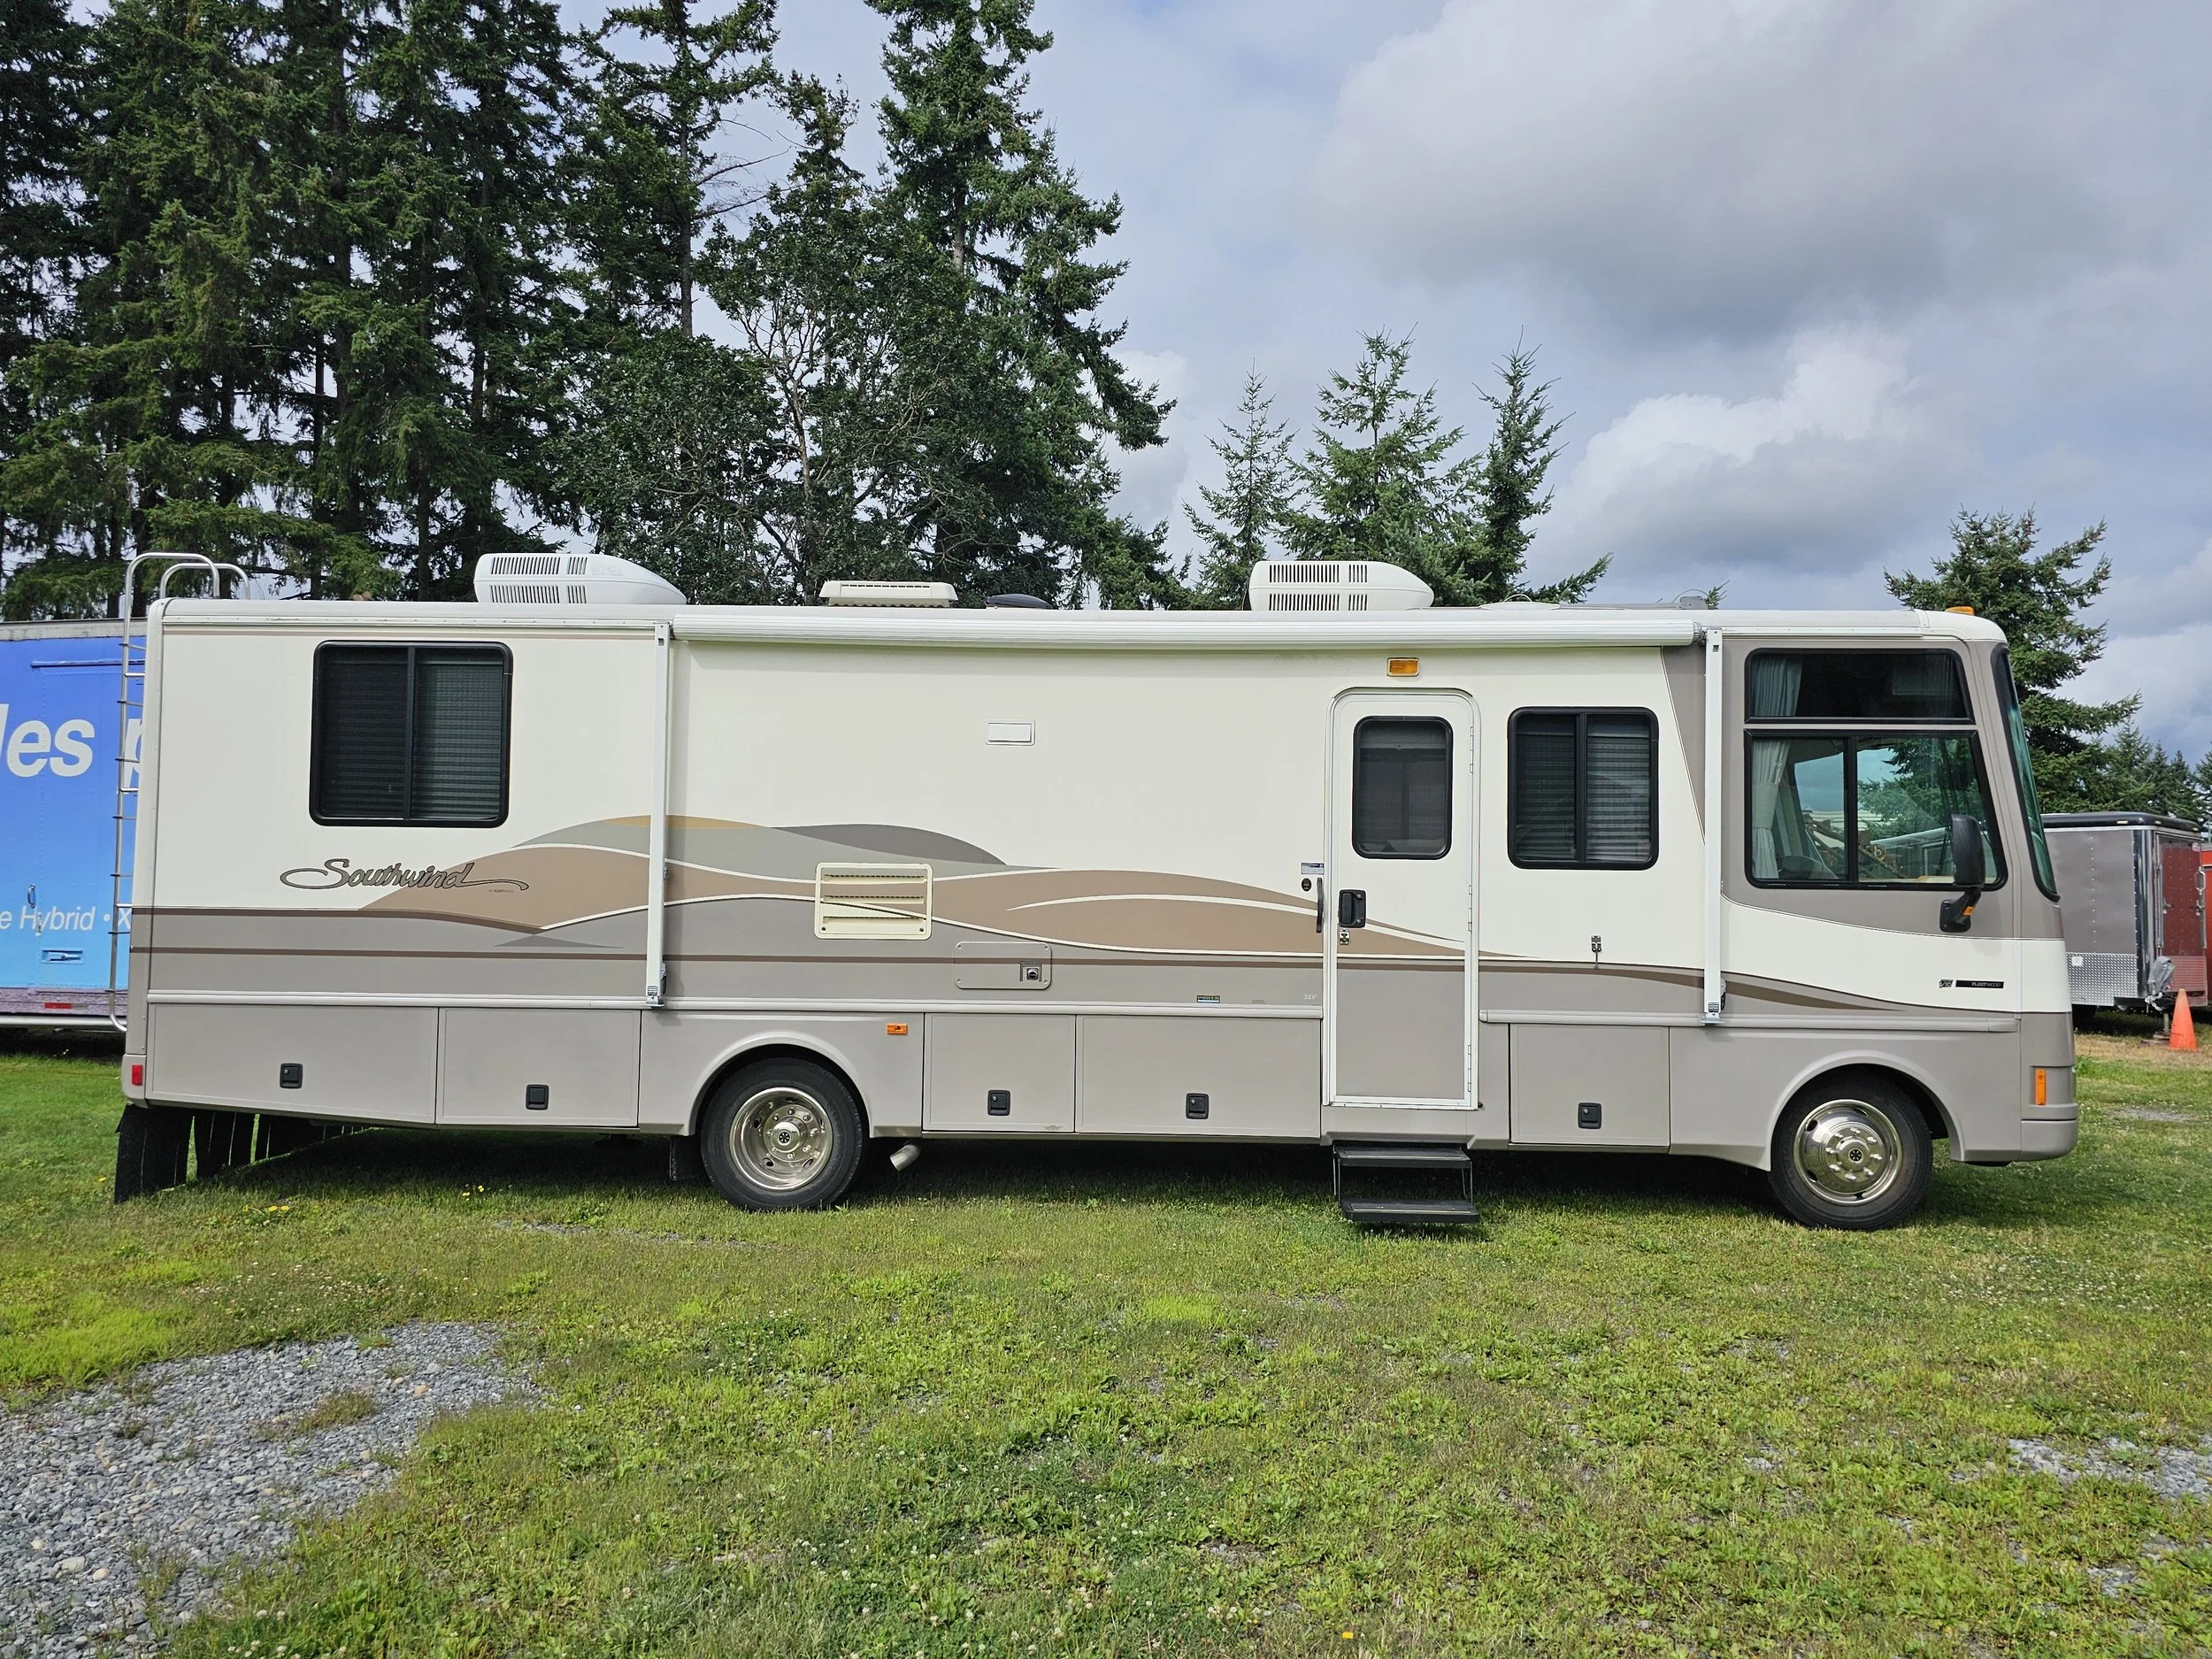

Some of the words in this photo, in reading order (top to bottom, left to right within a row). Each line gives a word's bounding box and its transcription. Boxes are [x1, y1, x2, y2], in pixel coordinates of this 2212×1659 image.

[0, 704, 95, 777] es
[280, 858, 529, 889] Southwind
[19, 905, 96, 937] Hybrid
